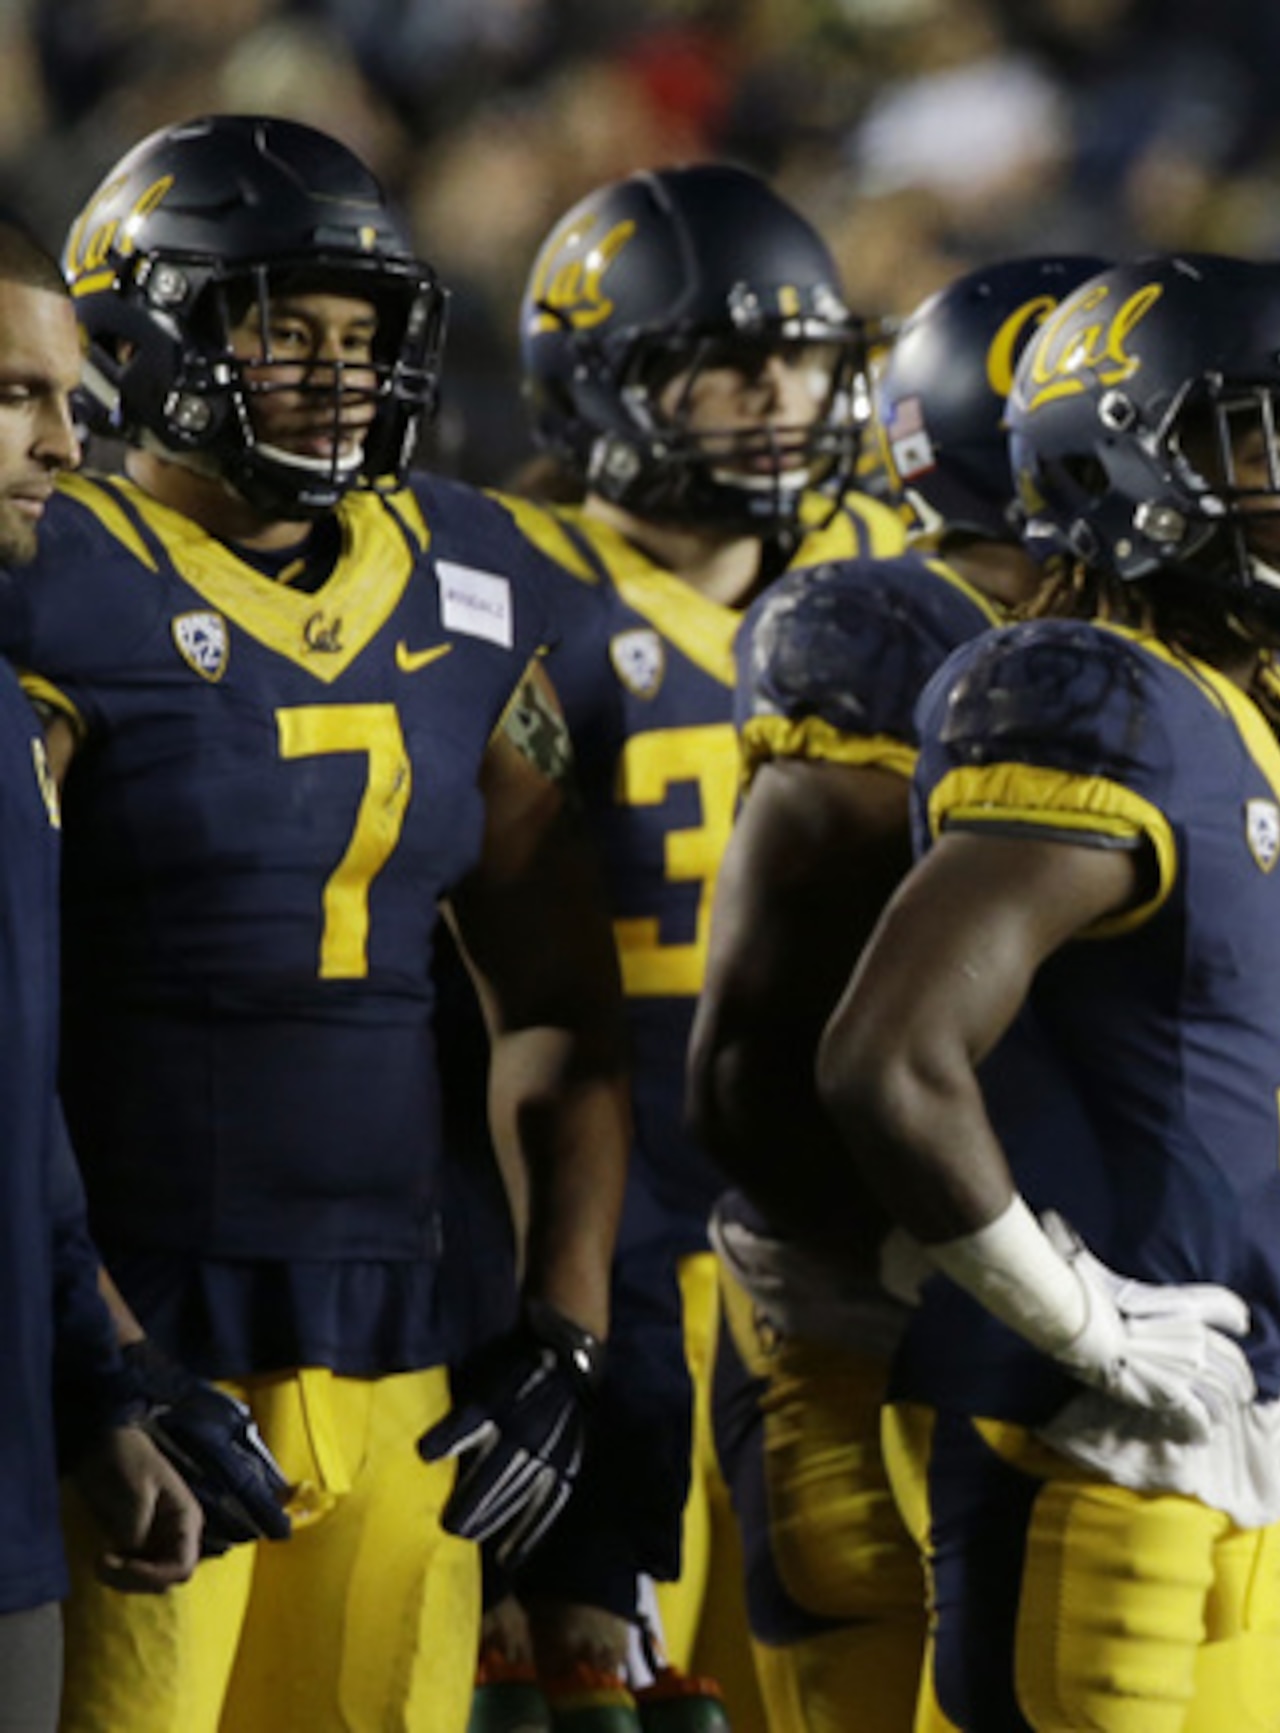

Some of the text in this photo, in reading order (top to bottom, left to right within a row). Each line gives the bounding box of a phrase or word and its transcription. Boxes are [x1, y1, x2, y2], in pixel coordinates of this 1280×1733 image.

[530, 214, 637, 334] Cal
[1022, 285, 1162, 412] Cal
[303, 611, 343, 653] Cal
[275, 703, 411, 979] 7
